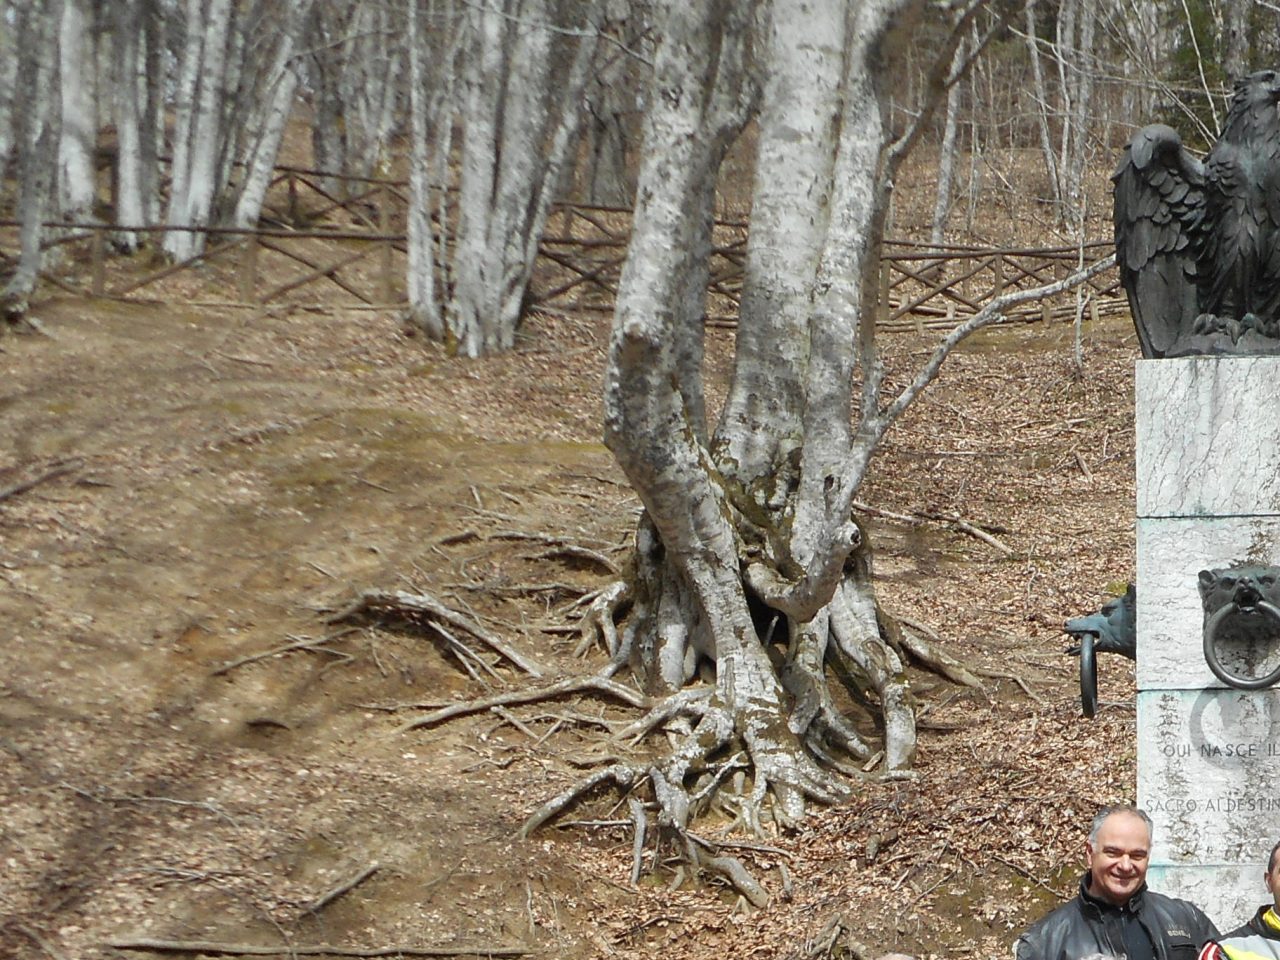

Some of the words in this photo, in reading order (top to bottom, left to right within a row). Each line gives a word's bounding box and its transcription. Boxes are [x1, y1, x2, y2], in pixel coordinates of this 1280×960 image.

[1200, 743, 1257, 758] NASCE
[1267, 743, 1280, 757] IL
[1145, 798, 1197, 812] SACRO
[1205, 799, 1220, 812] AI
